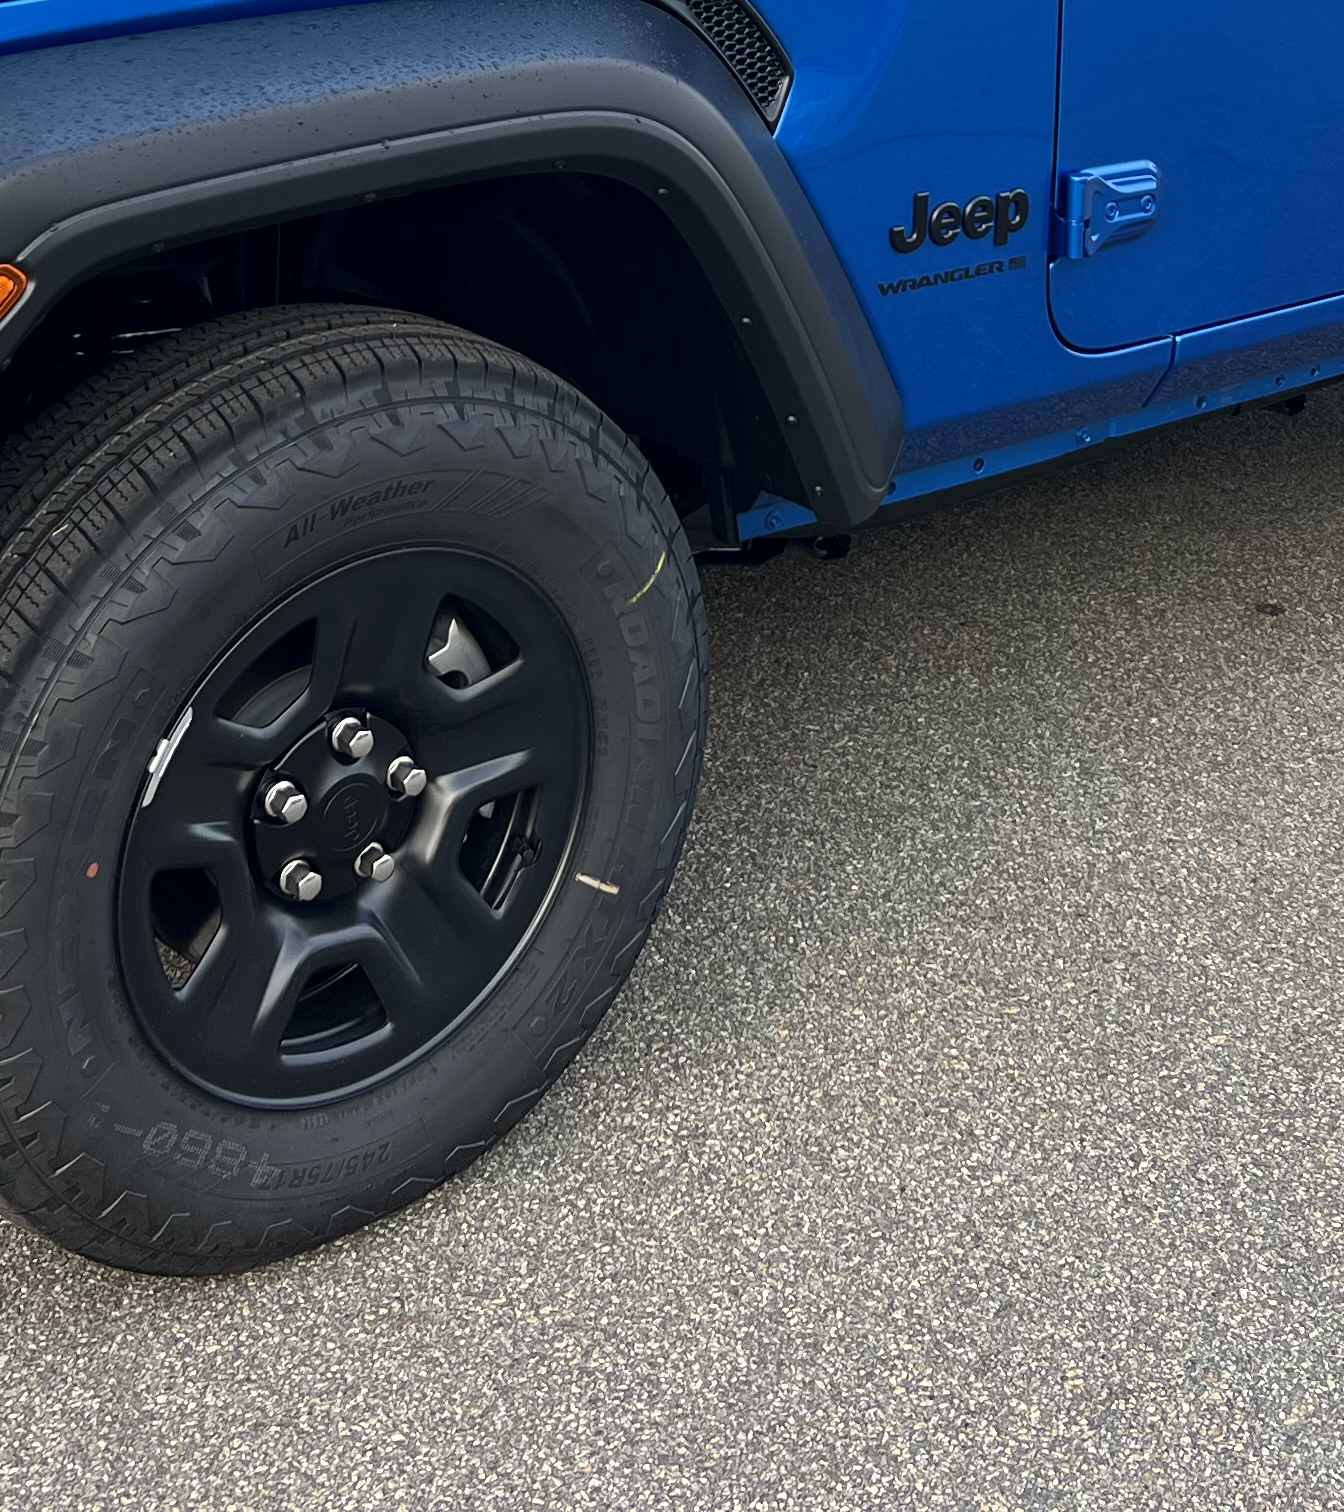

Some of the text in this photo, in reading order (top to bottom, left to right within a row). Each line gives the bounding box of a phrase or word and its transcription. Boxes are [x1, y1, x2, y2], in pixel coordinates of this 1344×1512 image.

[889, 187, 1029, 254] Jeep
[877, 260, 1005, 297] WRANGLER
[284, 478, 436, 550] All-Weather
